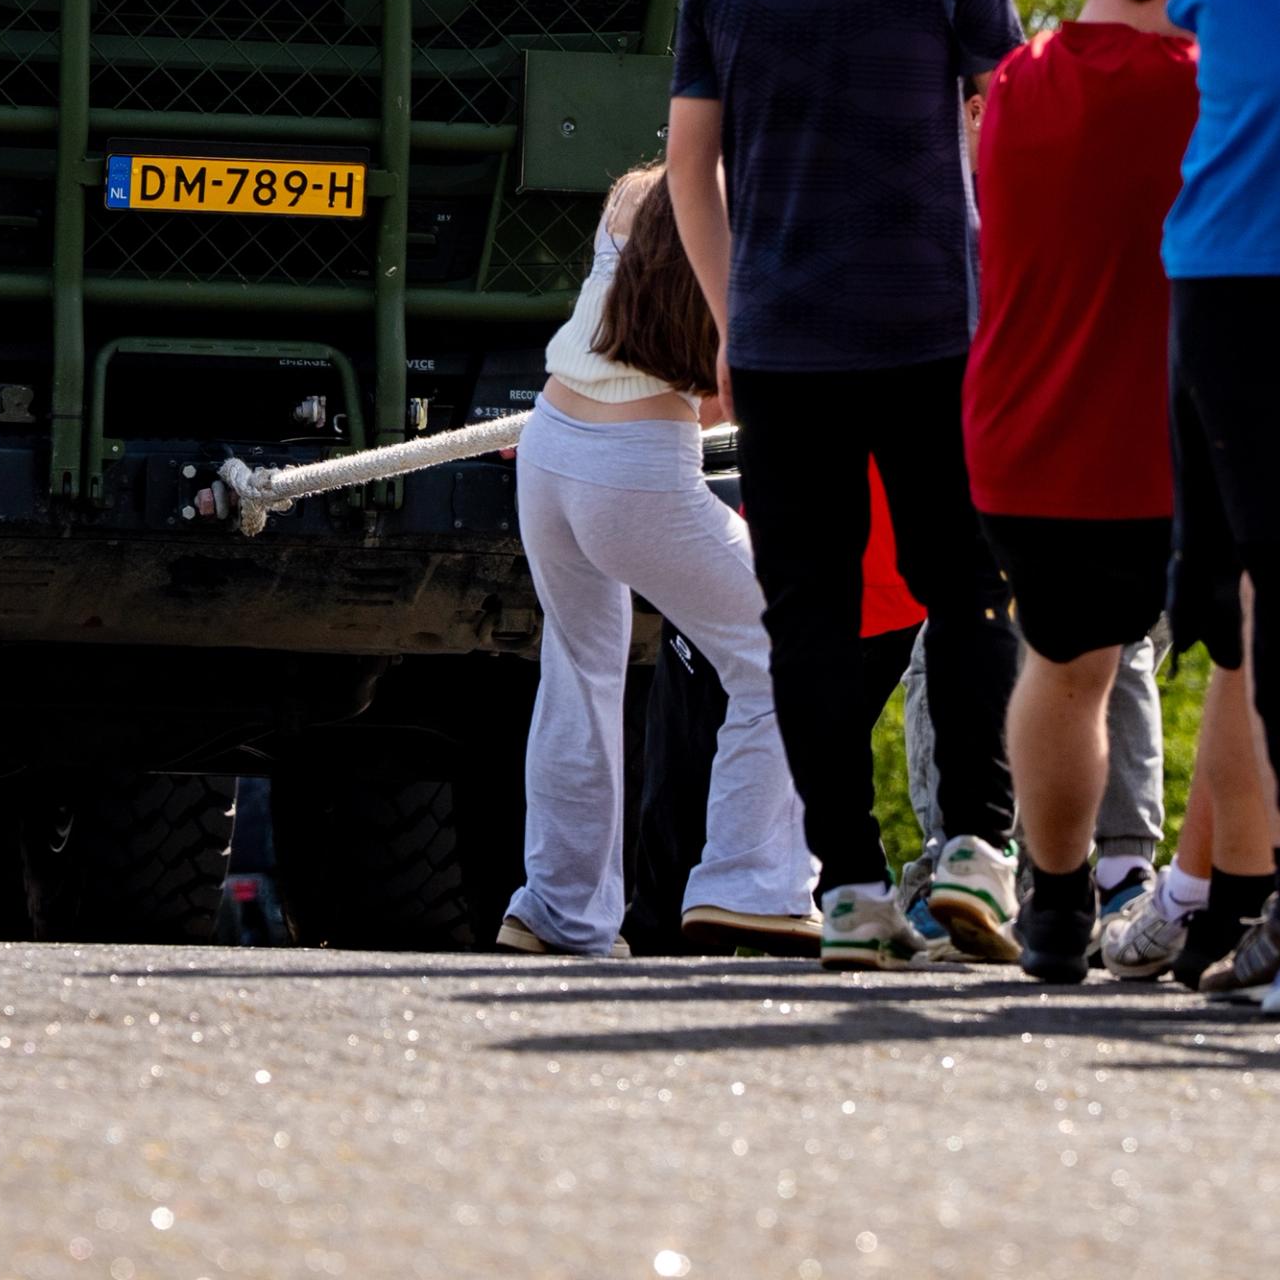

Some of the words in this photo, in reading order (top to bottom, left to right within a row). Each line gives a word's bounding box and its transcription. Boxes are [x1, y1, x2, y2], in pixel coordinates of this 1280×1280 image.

[140, 164, 354, 209] DM-789-H
[110, 187, 127, 199] NL
[279, 358, 332, 367] EMERGE
[406, 359, 435, 369] VICE
